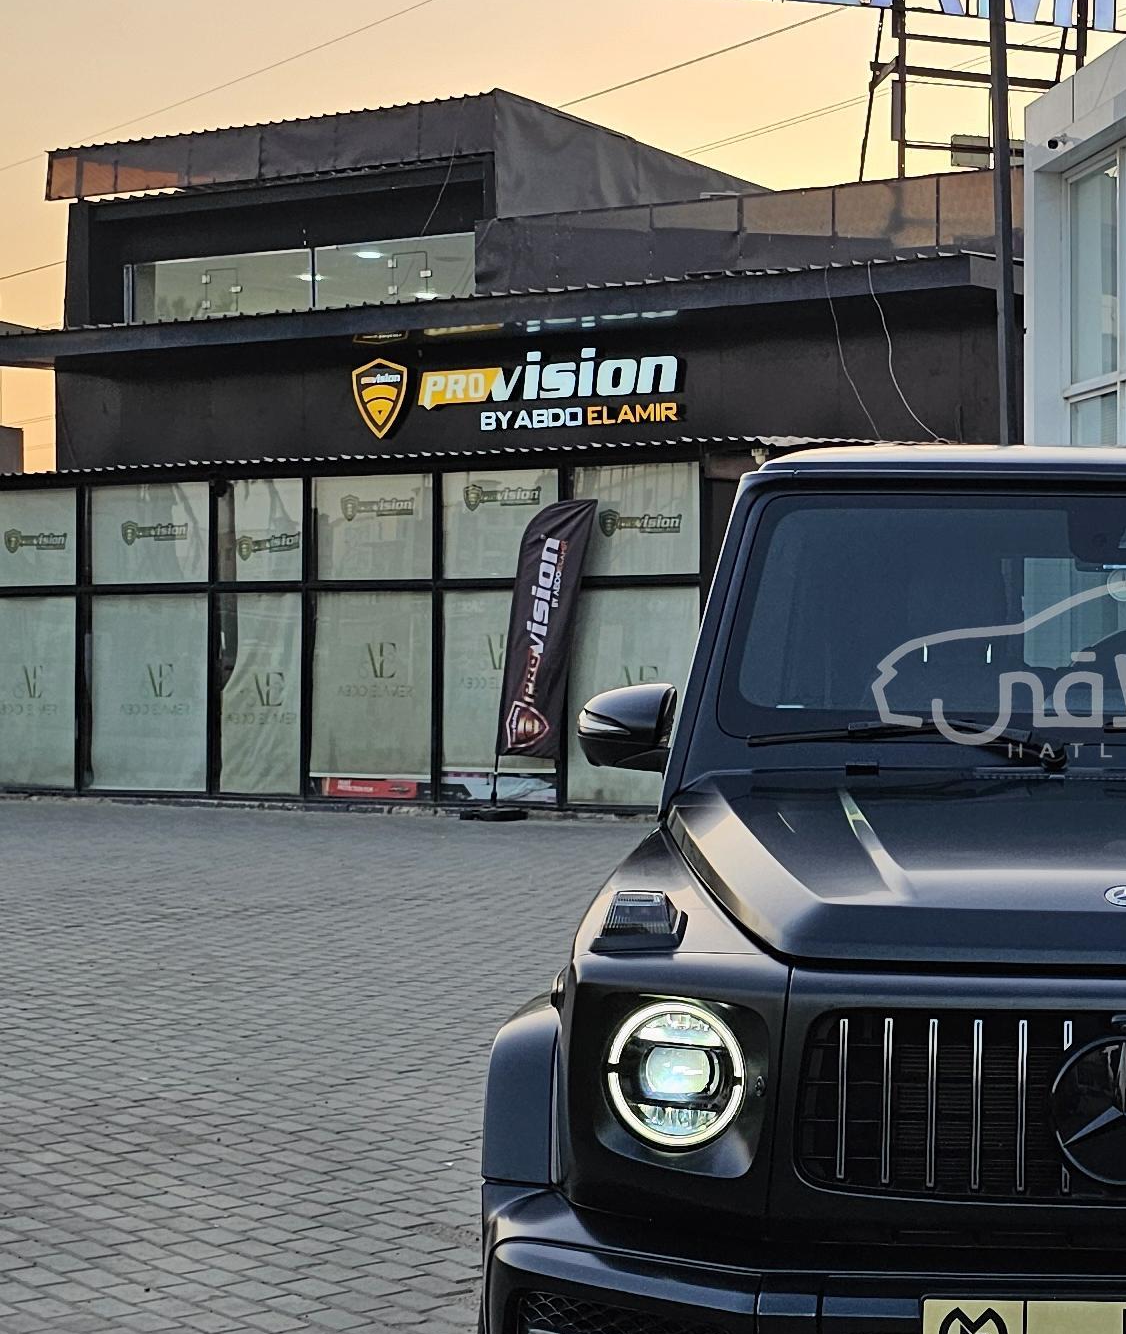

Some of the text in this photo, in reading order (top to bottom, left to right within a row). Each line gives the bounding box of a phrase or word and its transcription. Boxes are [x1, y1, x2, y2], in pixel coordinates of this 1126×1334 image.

[480, 403, 678, 431] BY ABDO ELAMIR
